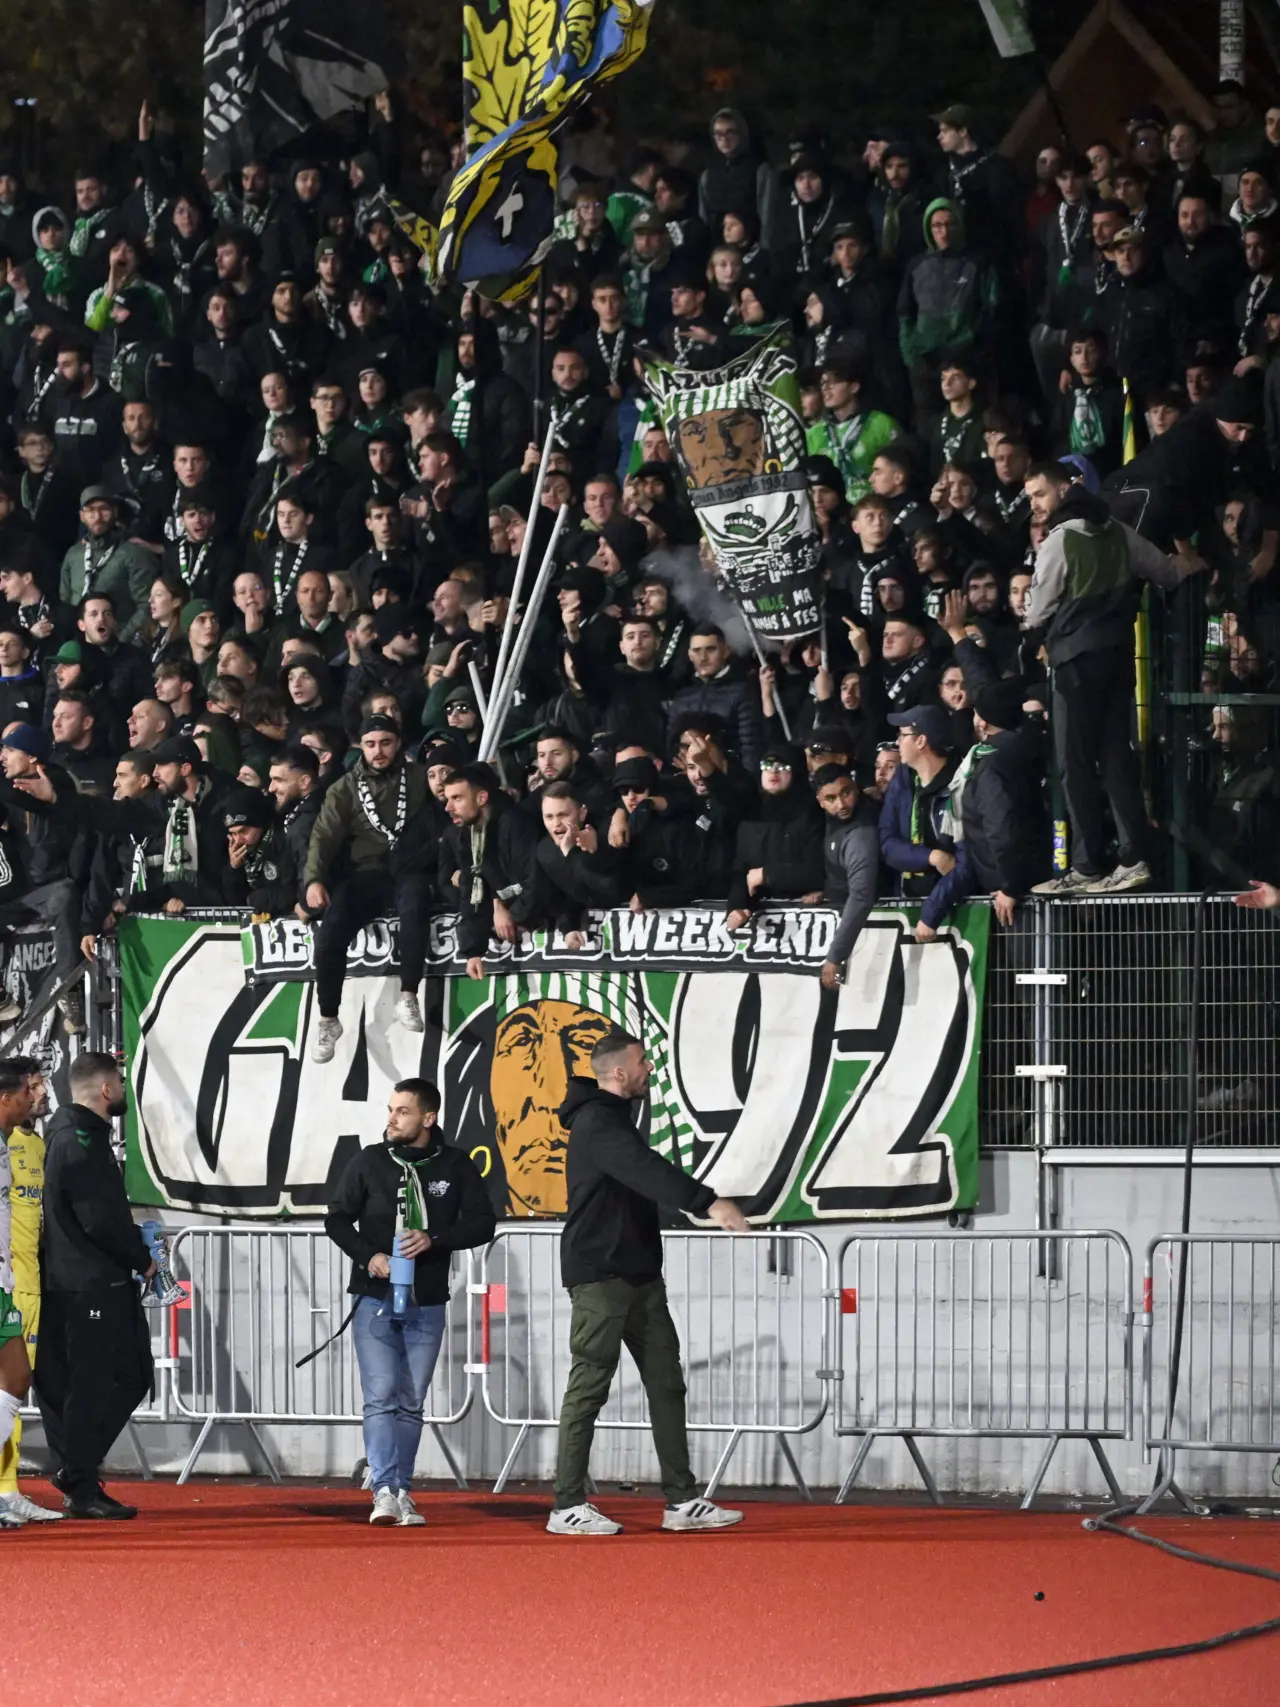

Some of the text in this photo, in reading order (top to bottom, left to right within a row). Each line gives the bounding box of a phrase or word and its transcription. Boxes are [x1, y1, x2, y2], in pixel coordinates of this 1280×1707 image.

[761, 473, 789, 490] 1992
[793, 587, 814, 606] MA
[793, 605, 819, 626] TES
[260, 919, 310, 963] LE
[135, 920, 970, 1210] GA 92
